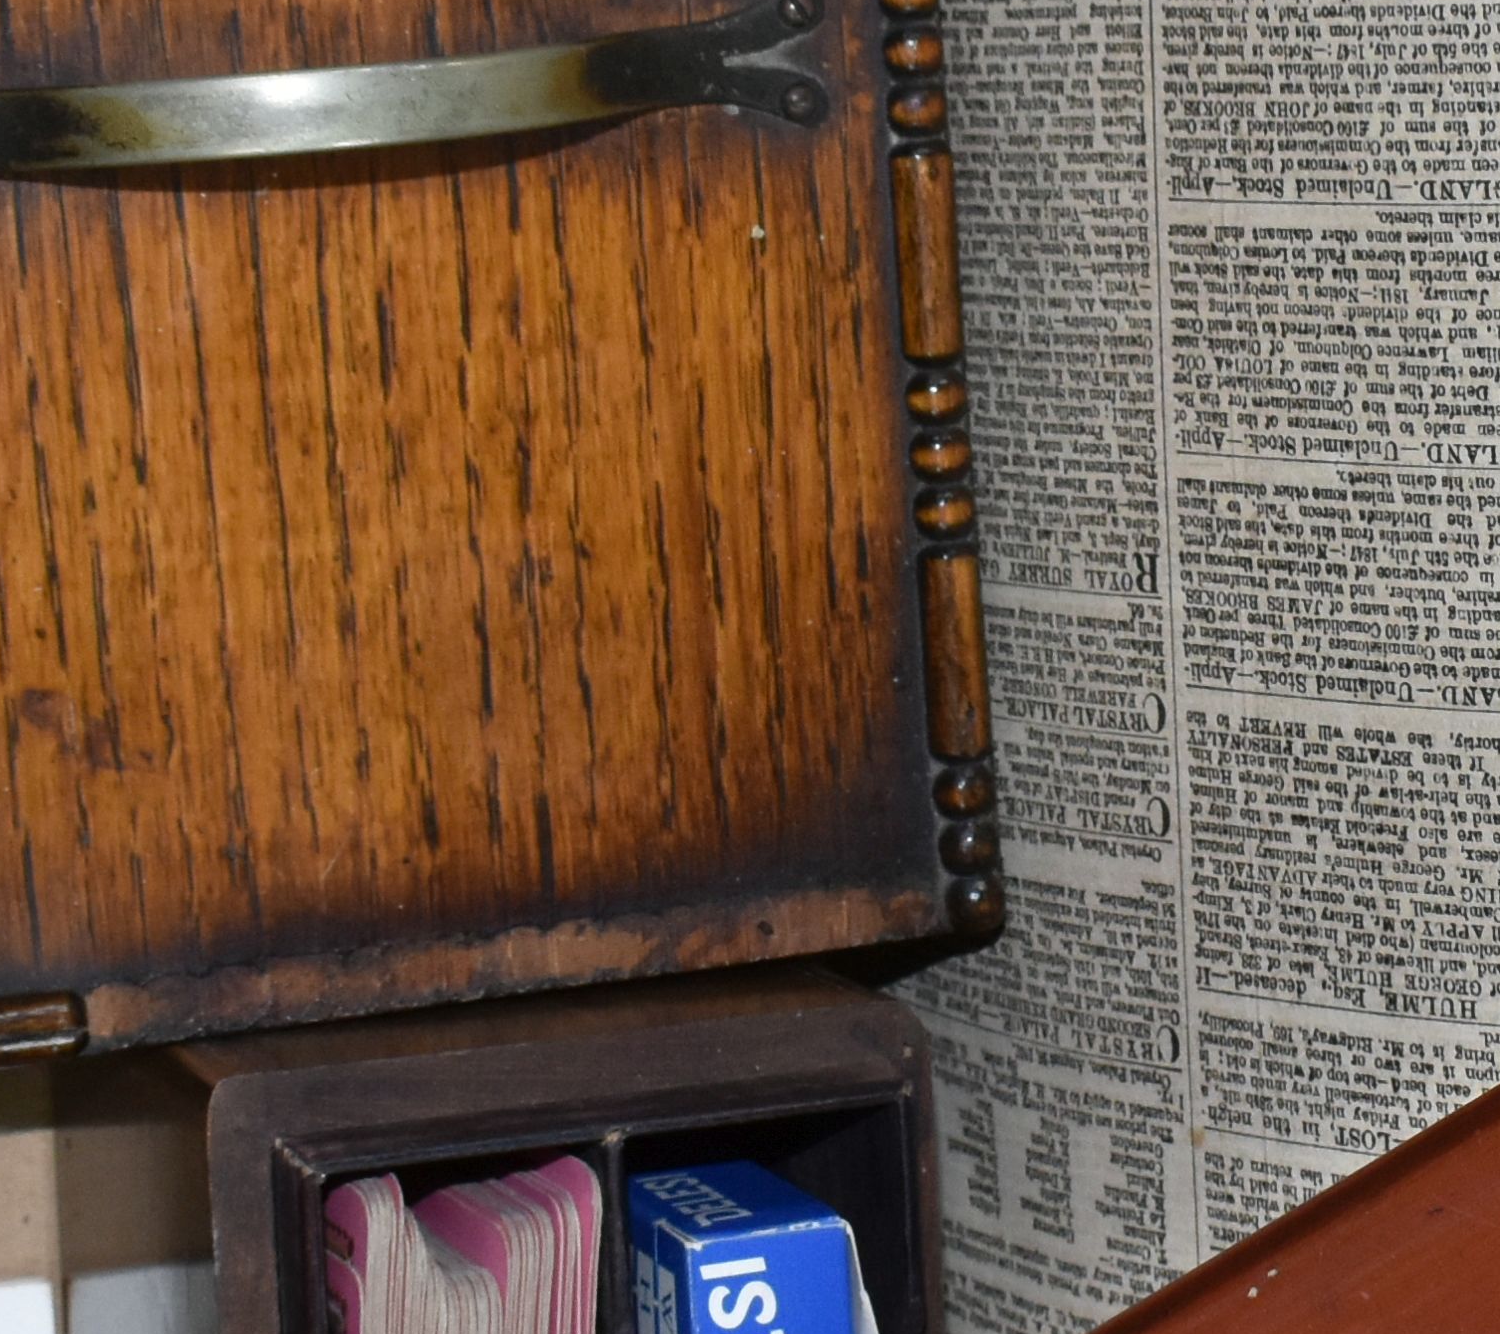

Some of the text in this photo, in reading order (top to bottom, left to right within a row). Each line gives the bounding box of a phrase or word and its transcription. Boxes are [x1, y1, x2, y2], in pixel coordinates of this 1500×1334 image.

[1008, 553, 1158, 597] ROYAL SURREY
[1321, 977, 1365, 1005] Esq.,
[1379, 989, 1478, 1021] HULME,
